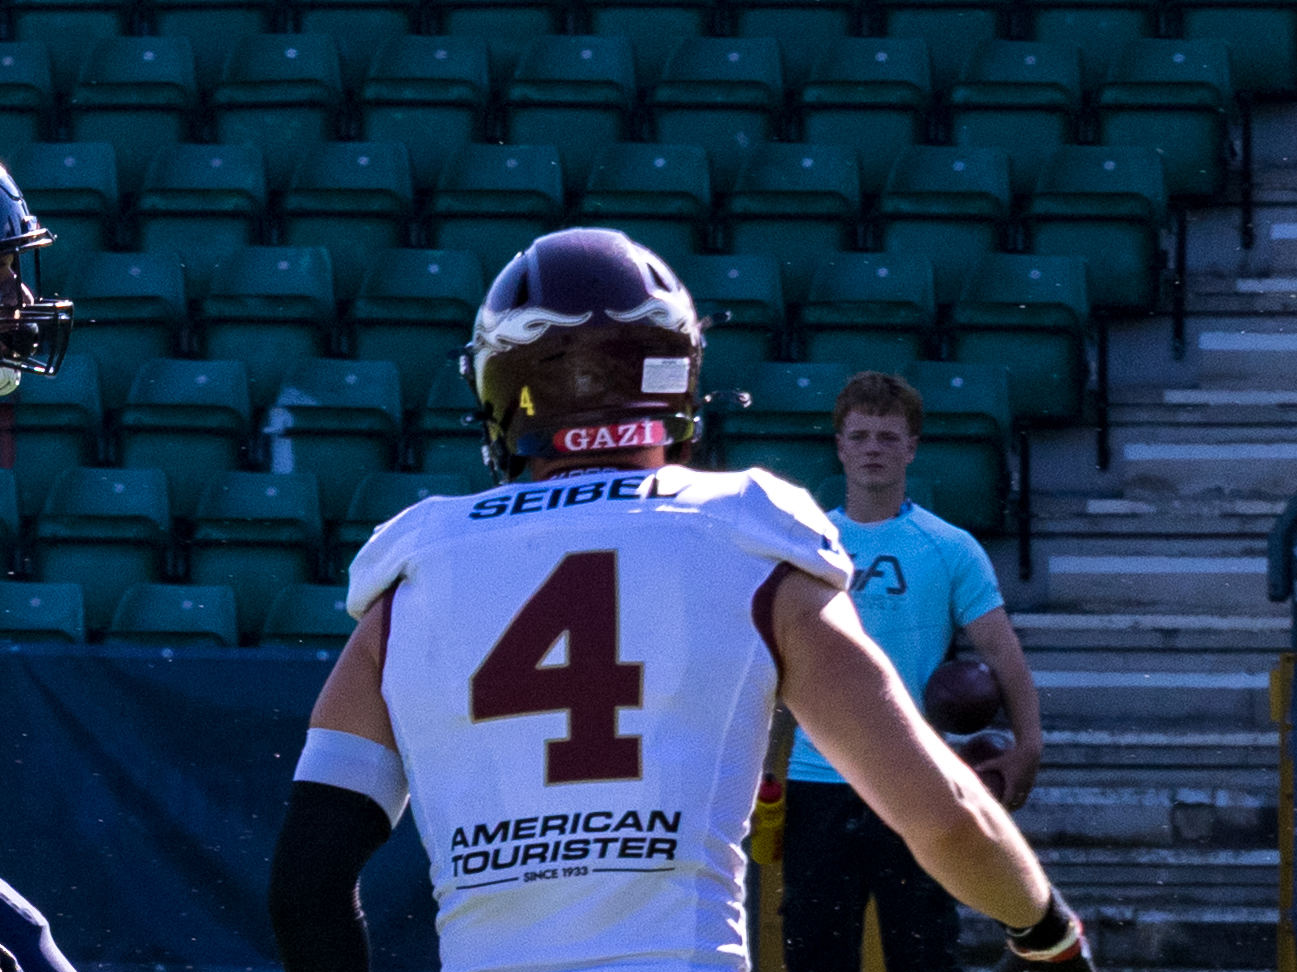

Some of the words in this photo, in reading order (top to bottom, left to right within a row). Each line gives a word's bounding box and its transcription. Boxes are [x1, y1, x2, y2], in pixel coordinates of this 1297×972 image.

[519, 385, 535, 416] 4
[469, 476, 680, 520] SEIBEL
[469, 548, 644, 787] 4
[451, 810, 682, 850] AMERICAN
[451, 837, 678, 877] TOURISTER
[523, 868, 558, 882] SINCE
[562, 866, 588, 877] 1933
